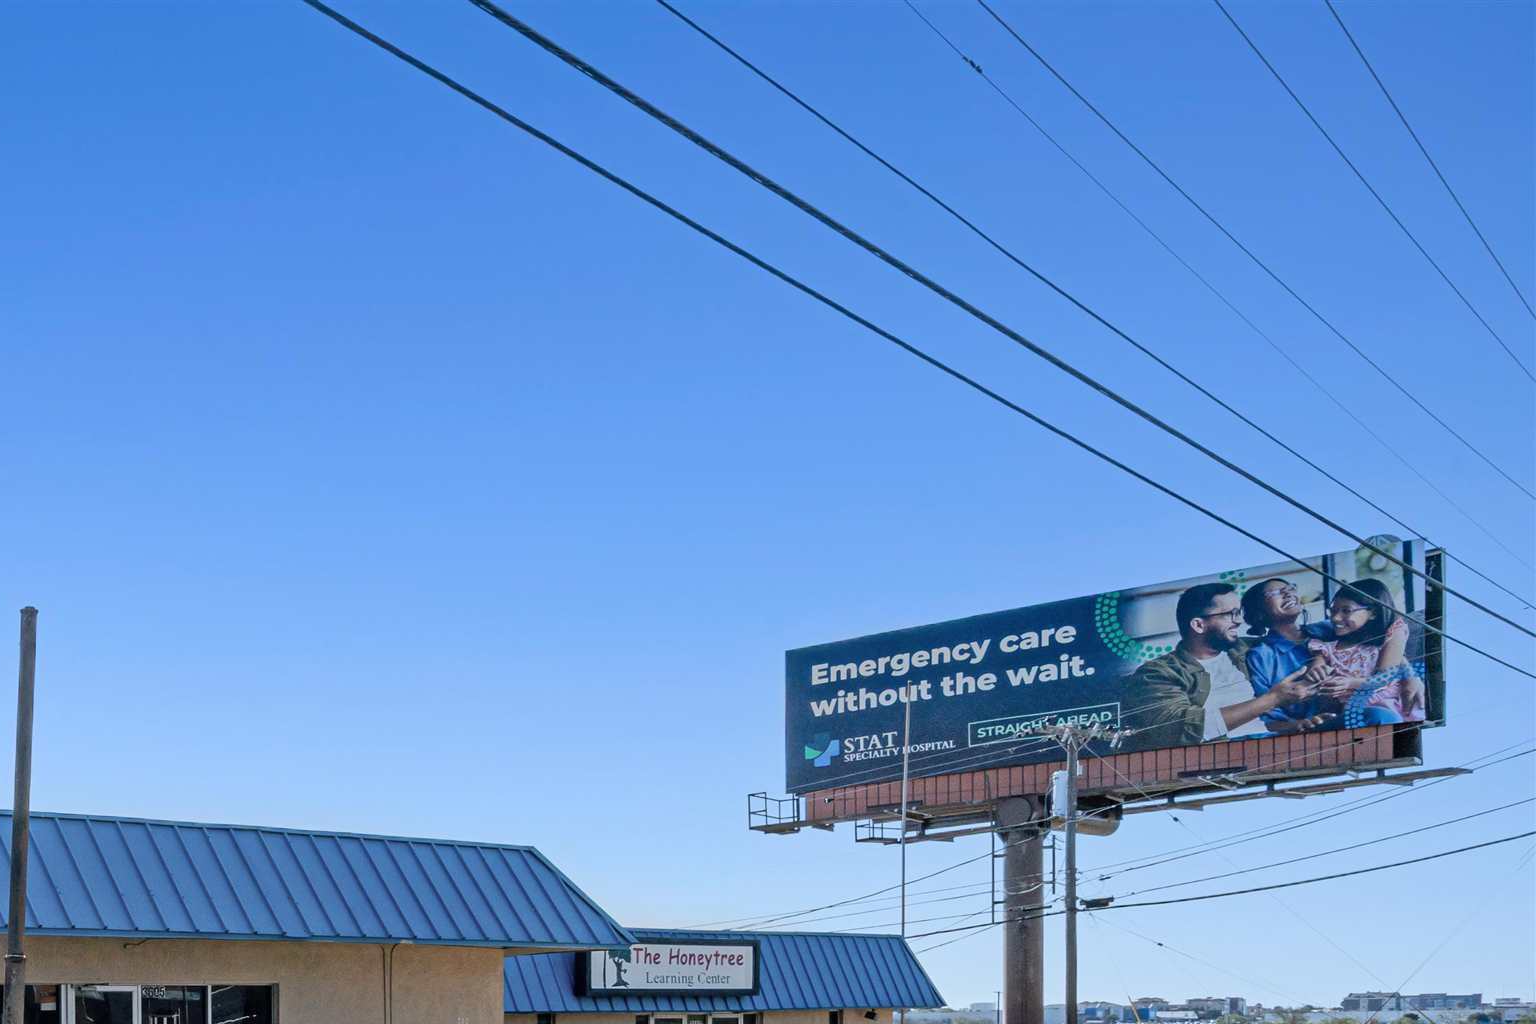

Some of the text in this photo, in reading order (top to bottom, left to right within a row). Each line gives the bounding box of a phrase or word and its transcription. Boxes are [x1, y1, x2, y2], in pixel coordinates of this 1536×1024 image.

[811, 625, 1077, 686] Emergency care
[810, 653, 1096, 718] without the wait.
[976, 711, 1113, 739] STRAIGH AHEAD
[843, 731, 898, 754] STAT
[843, 739, 957, 763] SPECIALTY HOSPITAL
[632, 947, 744, 971] The Honeytree
[646, 972, 732, 987] Learning Center
